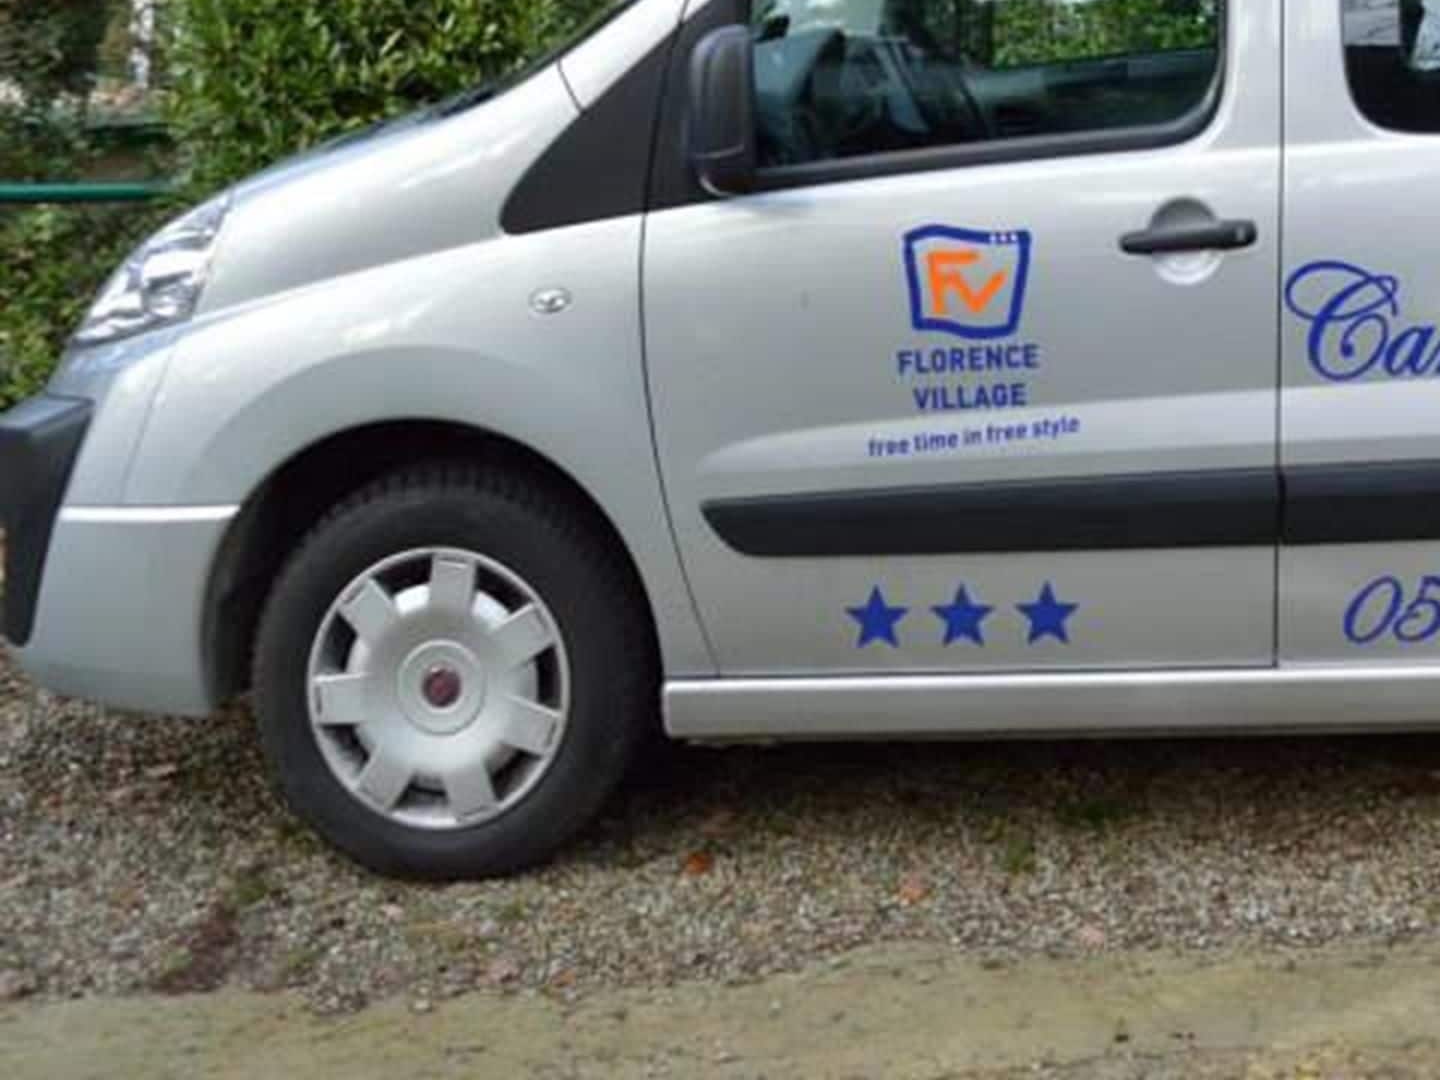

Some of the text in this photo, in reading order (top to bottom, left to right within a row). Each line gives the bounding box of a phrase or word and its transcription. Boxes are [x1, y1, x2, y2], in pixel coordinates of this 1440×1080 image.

[897, 344, 1040, 375] FLORENCE
[913, 383, 1027, 412] VILLAGE
[868, 415, 1081, 458] free time in free style
